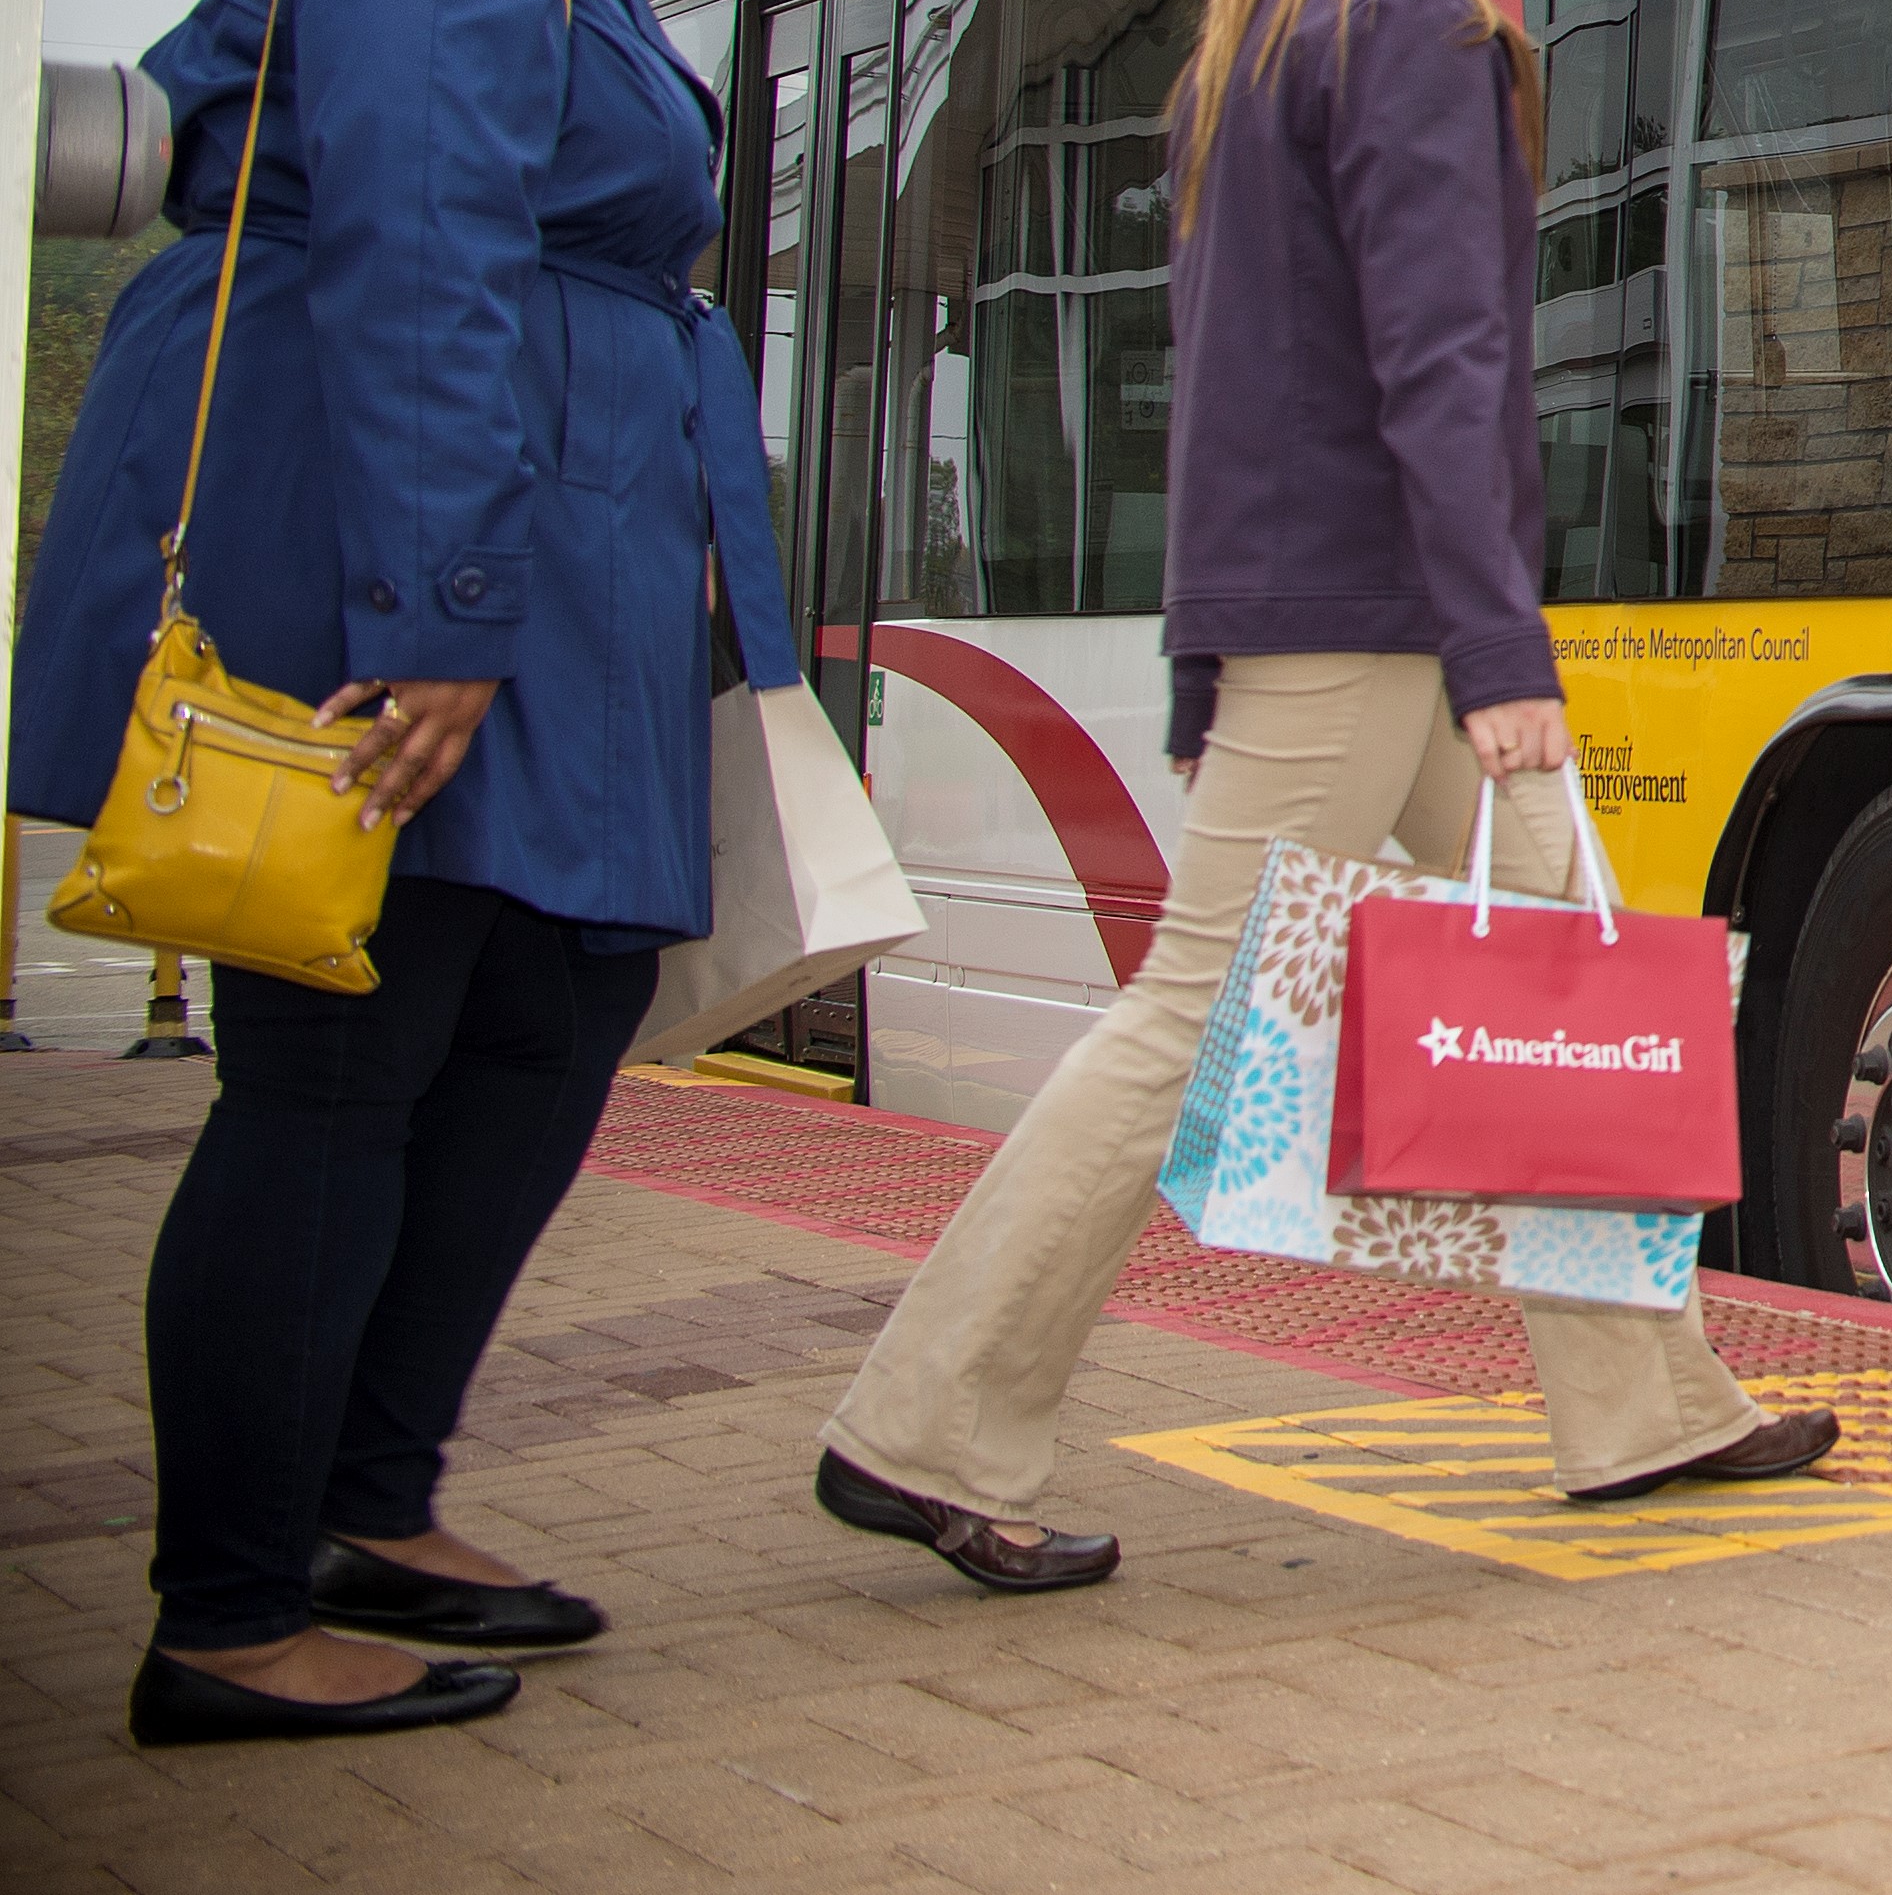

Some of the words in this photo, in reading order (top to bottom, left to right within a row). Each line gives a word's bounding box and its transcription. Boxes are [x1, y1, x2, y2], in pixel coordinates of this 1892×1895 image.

[1553, 630, 1600, 660] service
[1603, 626, 1620, 660] of
[1622, 626, 1646, 659] the
[1650, 626, 1746, 672] Metropolitan
[1750, 626, 1810, 661] Council
[1578, 734, 1634, 773] Transit
[1580, 769, 1688, 811] mprovement
[1466, 1025, 1622, 1070] American
[1622, 1033, 1685, 1074] Girl
